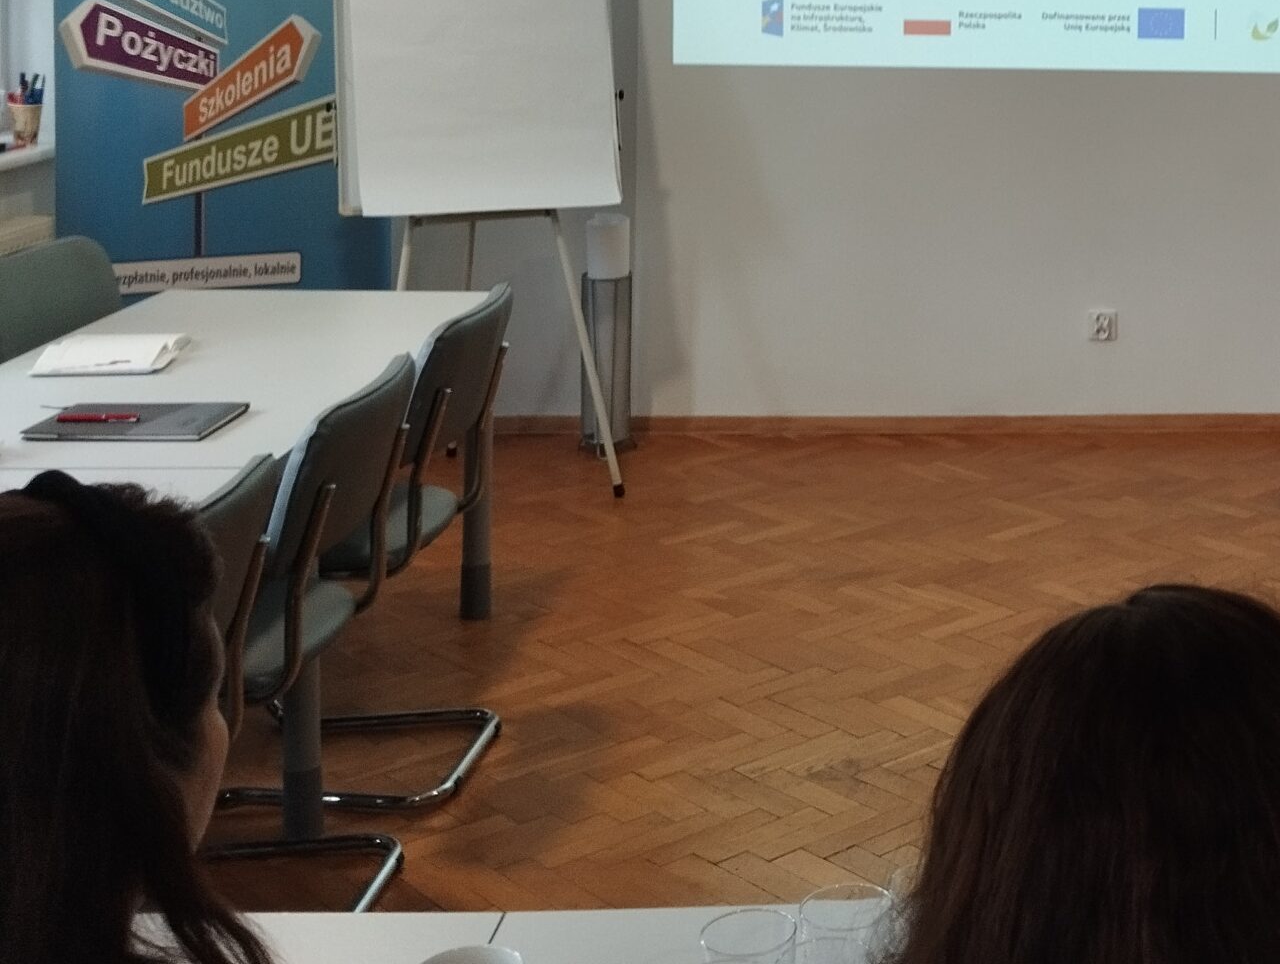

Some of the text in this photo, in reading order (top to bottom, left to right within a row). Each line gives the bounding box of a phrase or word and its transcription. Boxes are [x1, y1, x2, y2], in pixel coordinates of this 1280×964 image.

[95, 12, 215, 78] Pożyczki
[199, 43, 292, 123] Szkolenia
[162, 111, 336, 190] Fundusze UE
[115, 261, 297, 287] ezpłatnie, profesjonalnie, lokalnie
